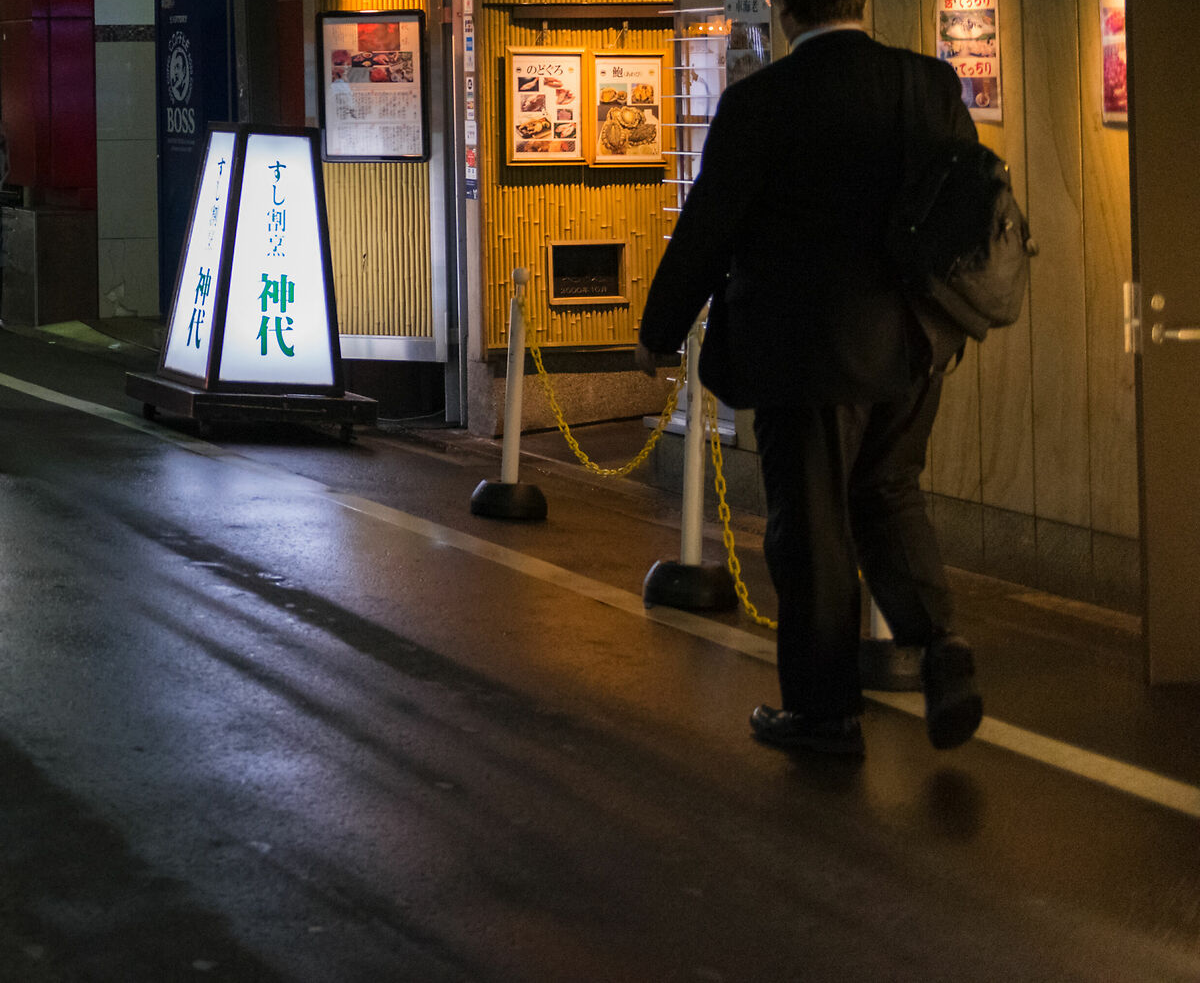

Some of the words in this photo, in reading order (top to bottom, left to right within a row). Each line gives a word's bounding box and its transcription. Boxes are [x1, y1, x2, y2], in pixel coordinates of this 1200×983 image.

[526, 64, 564, 76] のどぐろ
[166, 107, 196, 134] BOSS
[186, 266, 212, 349] 神代
[256, 272, 296, 358] 神代
